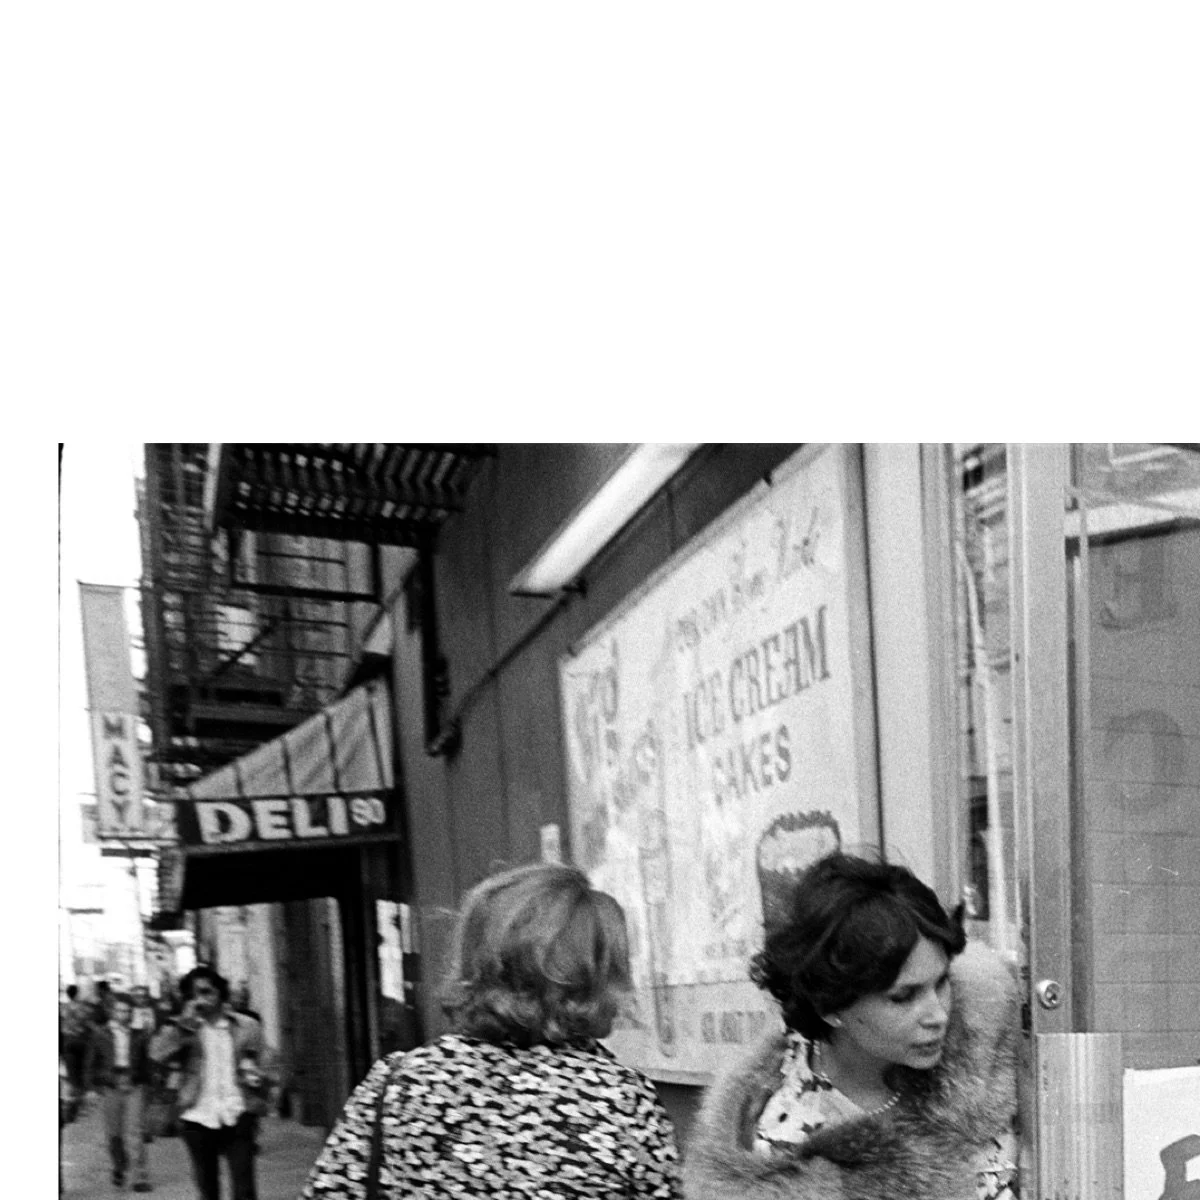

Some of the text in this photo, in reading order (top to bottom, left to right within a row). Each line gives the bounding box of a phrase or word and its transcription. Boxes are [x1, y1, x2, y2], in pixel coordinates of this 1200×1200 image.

[683, 668, 724, 751] ICE
[729, 603, 831, 725] CREAM
[711, 723, 792, 808] CAKES
[195, 796, 349, 844] DELI
